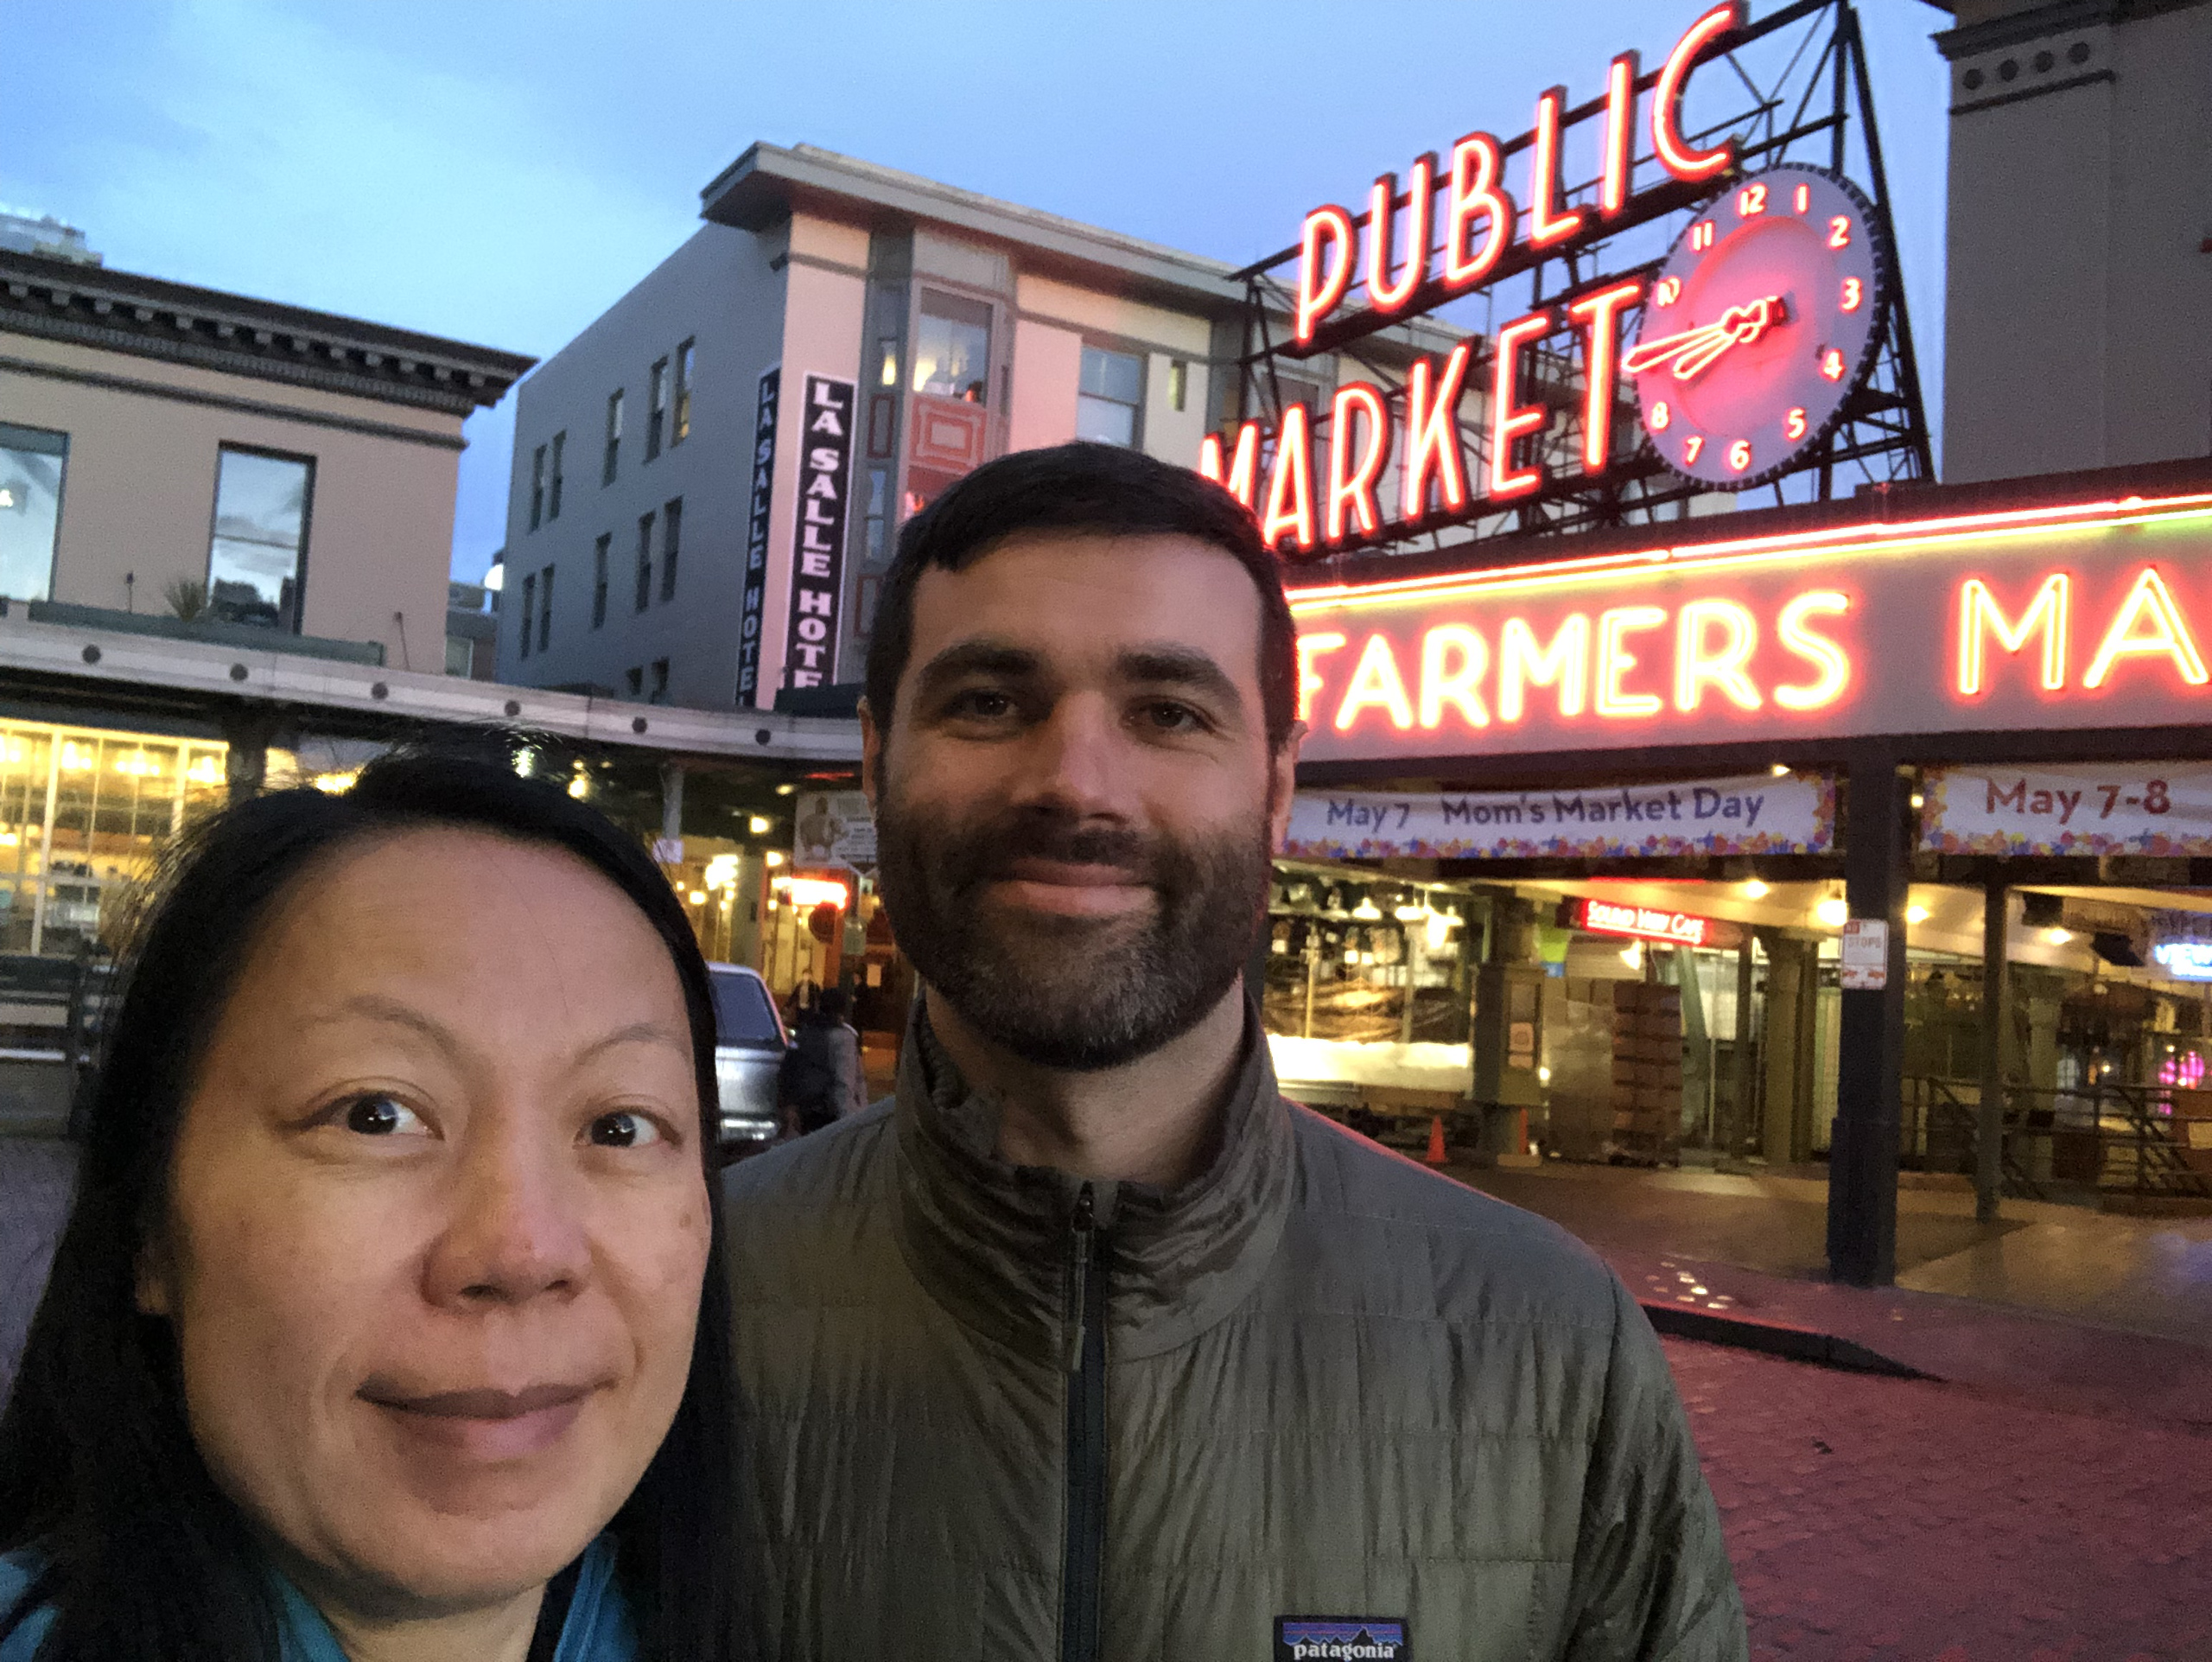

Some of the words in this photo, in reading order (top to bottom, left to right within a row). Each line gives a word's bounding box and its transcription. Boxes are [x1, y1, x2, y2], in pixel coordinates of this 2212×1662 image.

[1296, 3, 1744, 346] PUBLIC
[1738, 182, 1768, 218] 12
[1794, 183, 1808, 214] 1
[1691, 220, 1715, 252] 11
[1827, 215, 1851, 250] 2
[1656, 277, 1681, 307] 10
[1840, 277, 1862, 312] 3
[1821, 347, 1846, 382] 4
[759, 381, 775, 429] LA
[811, 381, 843, 436] LA
[1649, 401, 1670, 431] 8
[1785, 407, 1806, 441] 5
[1684, 436, 1704, 465] 7
[1727, 439, 1751, 471] 6
[749, 438, 772, 570] SALLE
[801, 448, 840, 578] SALLE
[1295, 589, 1851, 731] FARMERS
[1958, 567, 2209, 695] MA
[1326, 797, 1387, 834] May
[1394, 802, 1411, 830] 7
[1440, 793, 1546, 825] Mom's
[1552, 788, 1682, 823] Market
[1693, 786, 1765, 828] Day
[1986, 777, 2082, 825] May
[2096, 779, 2171, 819] 7-8
[1294, 1642, 1395, 1661] patagonia
